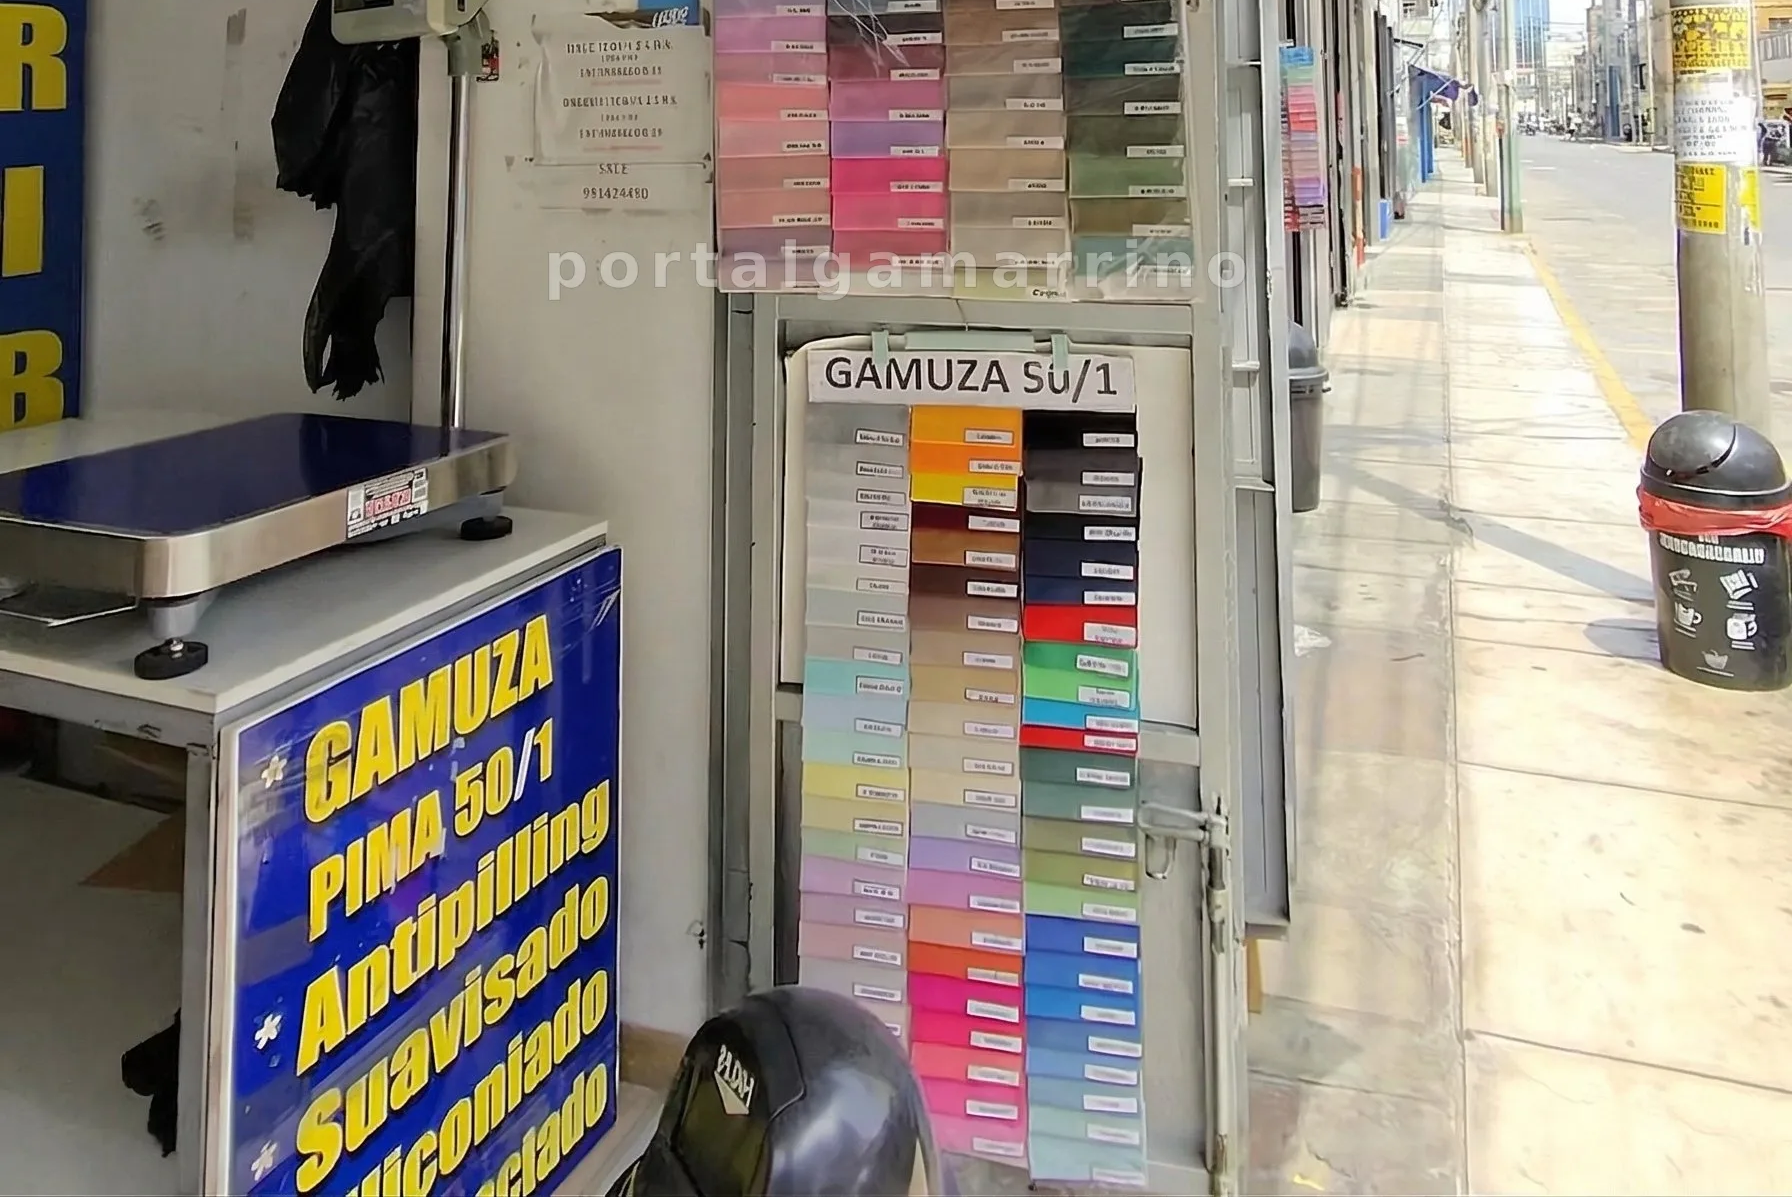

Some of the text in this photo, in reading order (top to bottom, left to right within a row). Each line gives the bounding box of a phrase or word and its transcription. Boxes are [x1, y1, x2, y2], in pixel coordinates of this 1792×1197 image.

[825, 356, 1010, 392] GAMUZA
[304, 614, 553, 823] GAMUZA
[309, 718, 553, 943] PIMA 50/1
[295, 876, 609, 1194] Suavisado
[297, 779, 610, 1077] Antipilling
[346, 969, 608, 1197] iconiado
[474, 1063, 608, 1197] clado
